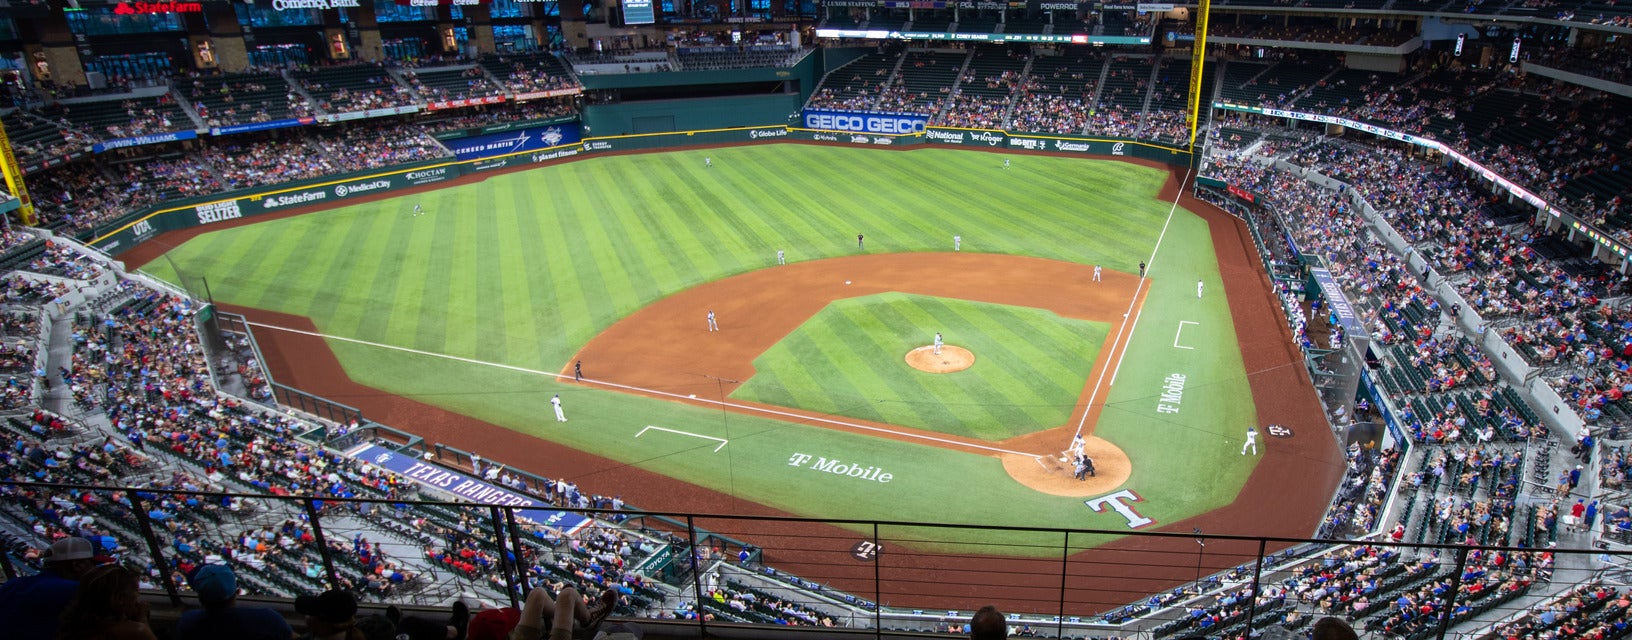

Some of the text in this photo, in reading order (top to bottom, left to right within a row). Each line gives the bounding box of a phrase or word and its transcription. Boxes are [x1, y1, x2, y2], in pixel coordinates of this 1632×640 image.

[806, 114, 927, 134] GEICO GEICO
[759, 130, 775, 138] Globe
[776, 129, 788, 137] Life
[934, 131, 964, 140] National
[980, 132, 1004, 146] Kroger
[487, 141, 514, 150] MARTIN
[538, 150, 578, 162] planet fitness
[408, 168, 447, 180] CHOCTAW
[197, 205, 243, 225] SELTZER
[132, 220, 153, 236] UTA
[1160, 373, 1187, 405] Mobile
[809, 457, 894, 483] Mobile
[404, 462, 533, 514] TEXAS RANGERS
[1084, 489, 1158, 531] T
[645, 550, 671, 572] TOYOTA
